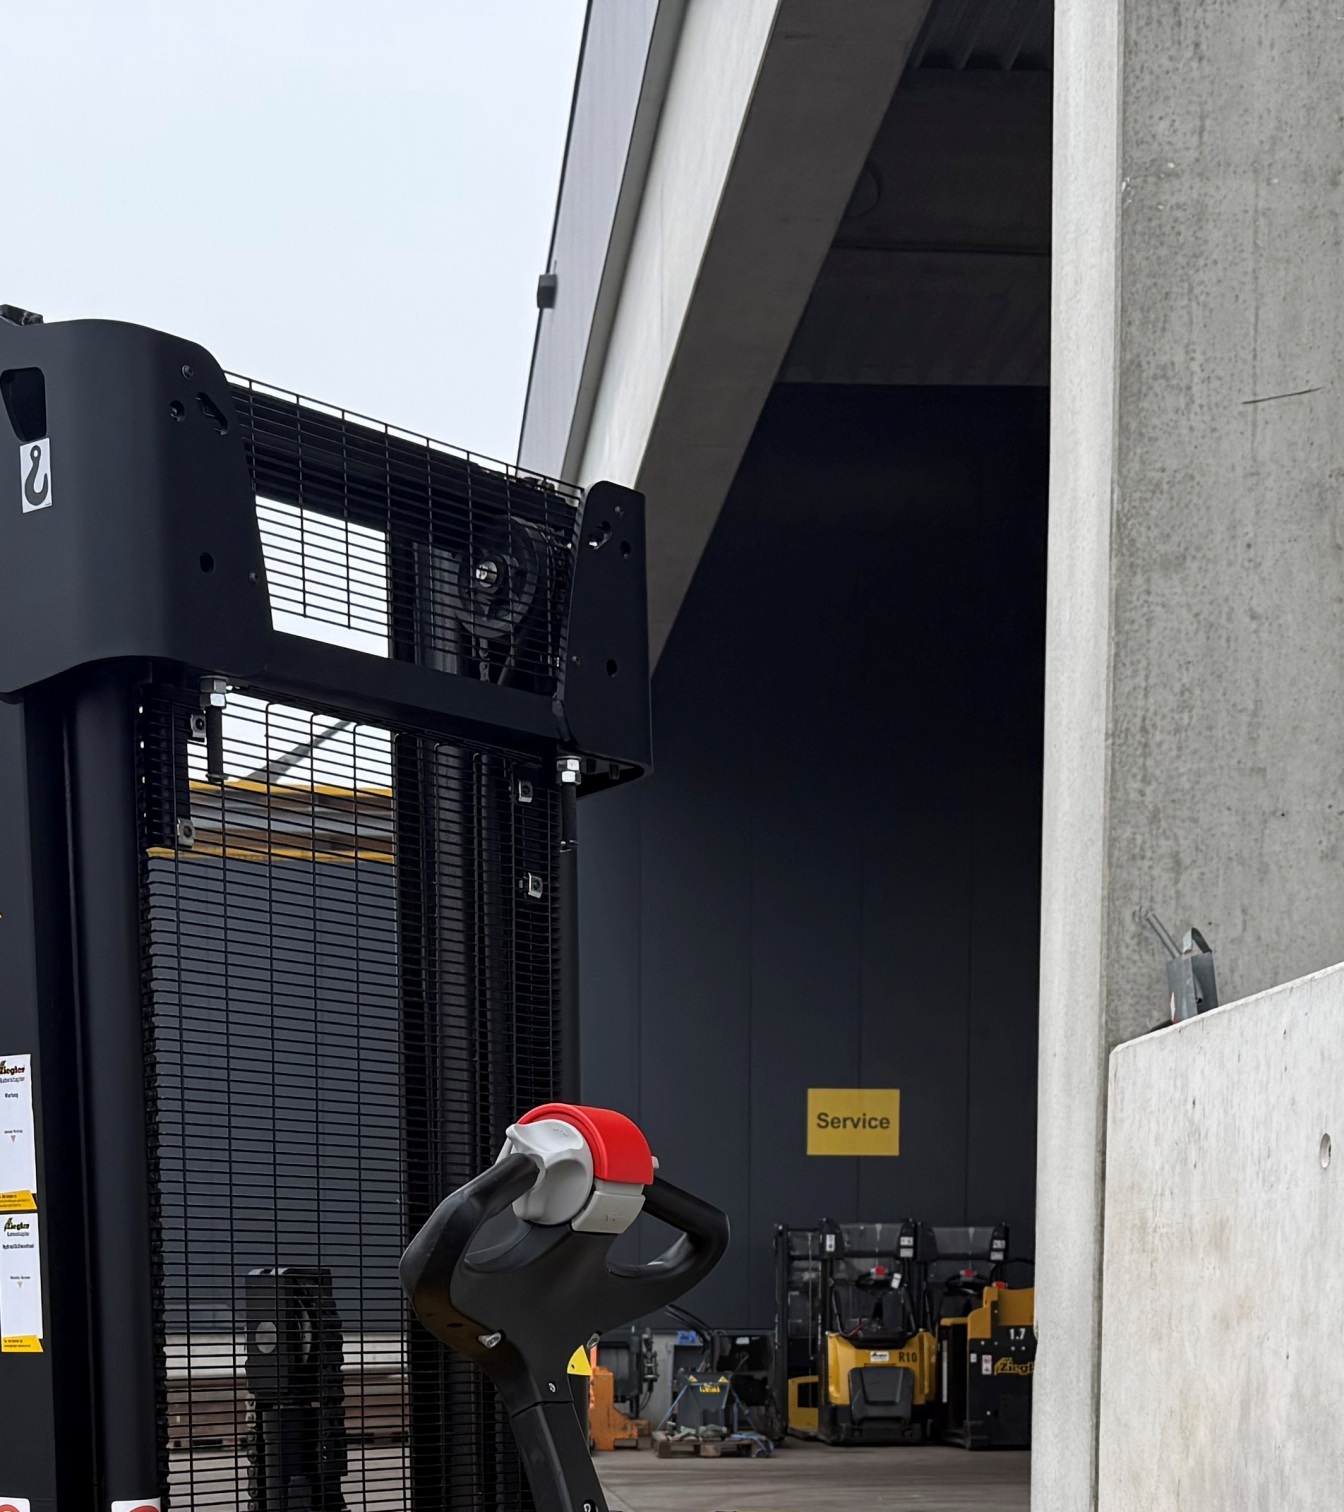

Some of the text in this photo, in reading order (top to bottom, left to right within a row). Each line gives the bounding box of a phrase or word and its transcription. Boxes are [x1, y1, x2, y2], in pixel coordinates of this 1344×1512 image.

[816, 1112, 891, 1130] Service
[1009, 1327, 1026, 1340] 1.7
[898, 1351, 918, 1363] R10
